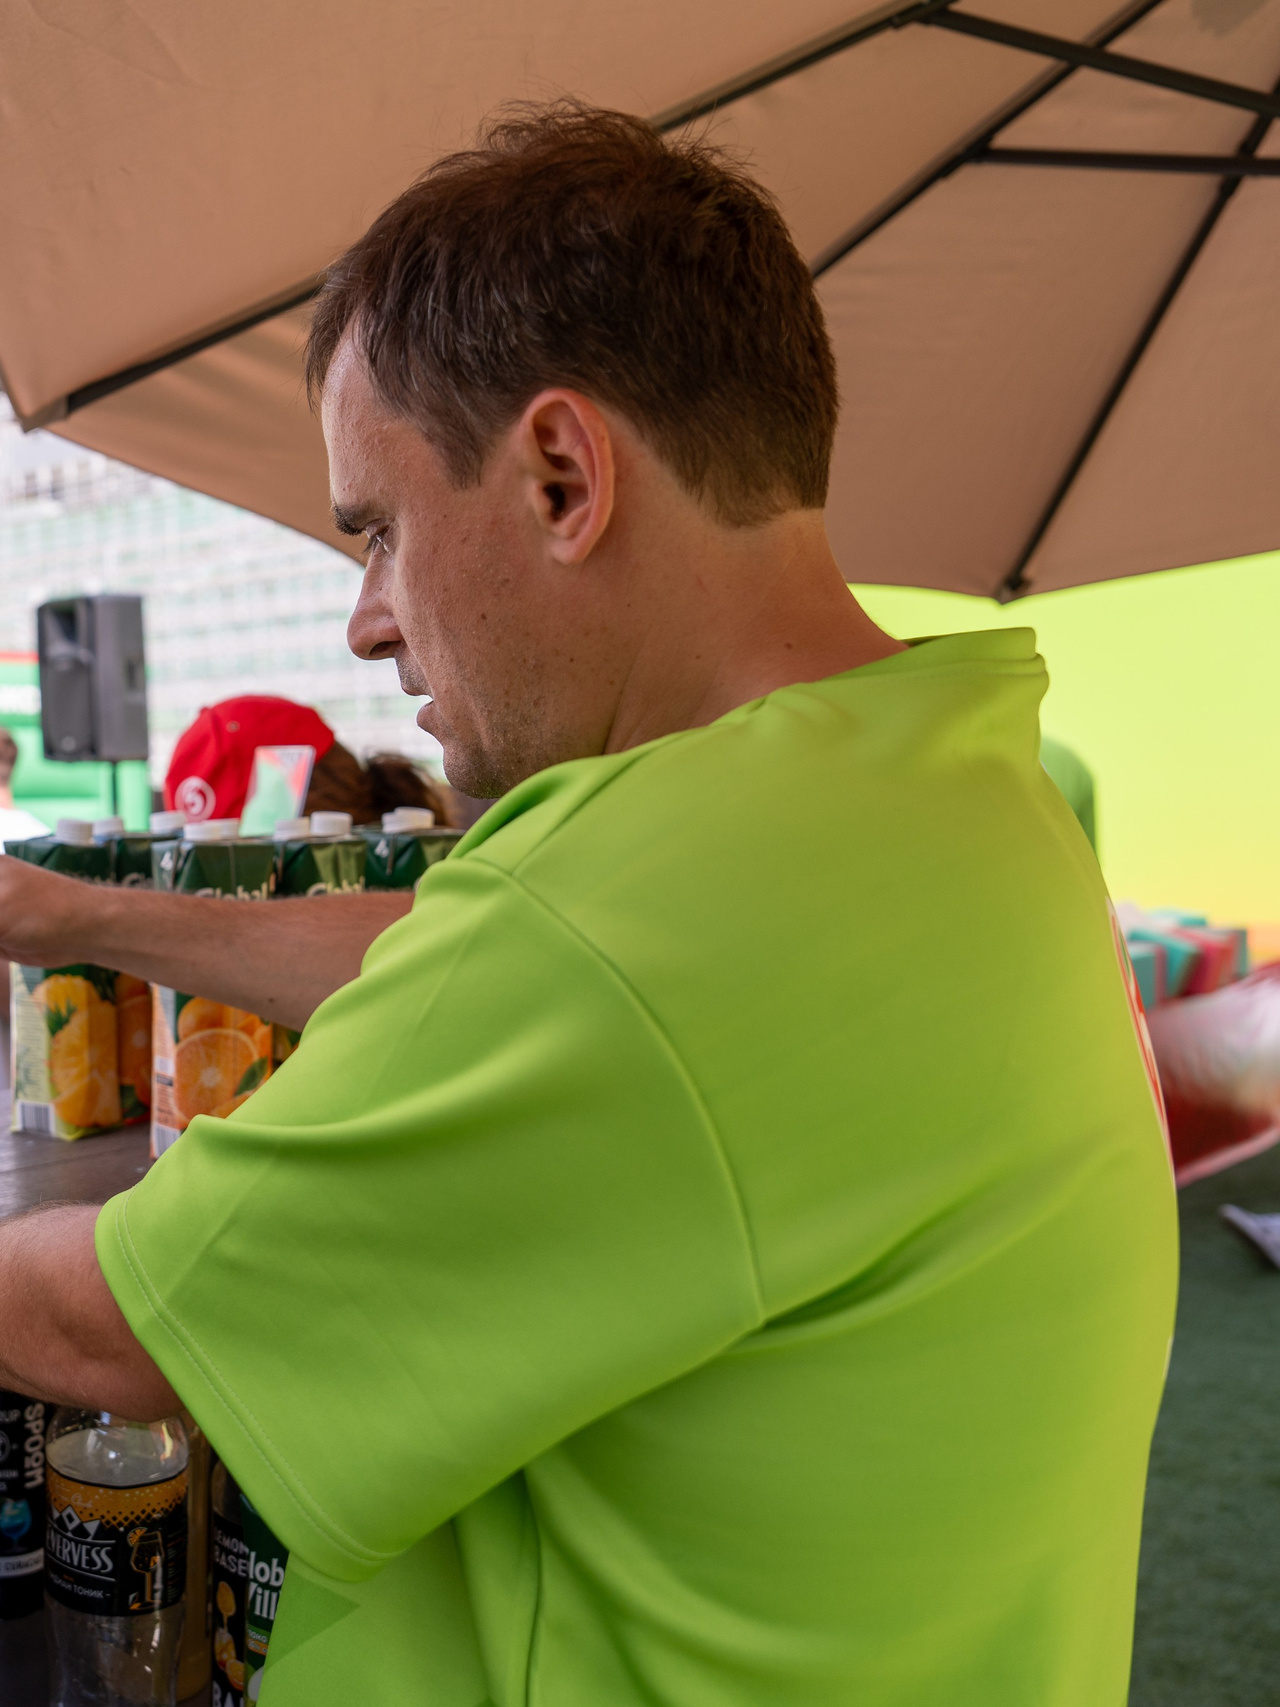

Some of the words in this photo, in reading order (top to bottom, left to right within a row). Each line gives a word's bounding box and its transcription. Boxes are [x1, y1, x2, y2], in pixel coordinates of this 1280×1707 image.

[46, 1524, 114, 1574] EVERVESS
[249, 1550, 285, 1586] lob
[74, 1585, 104, 1599] ТОНИК
